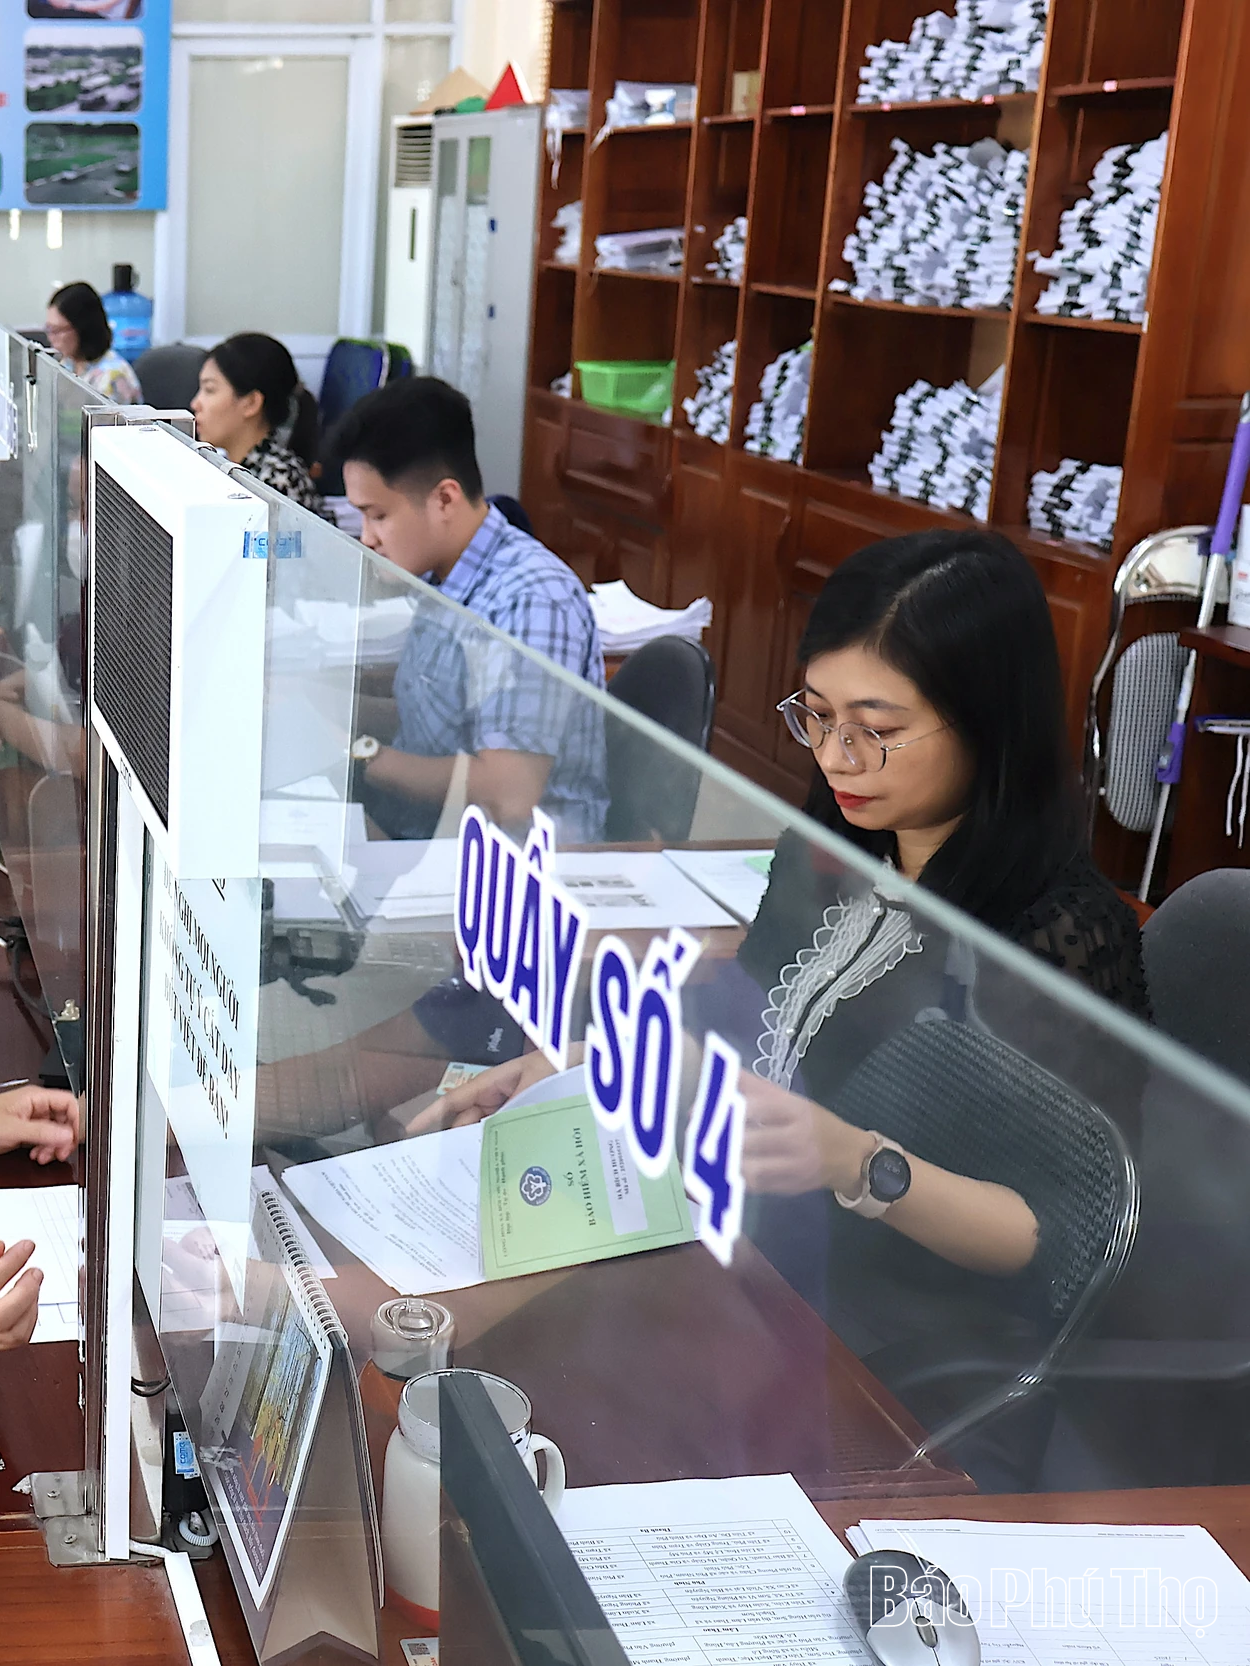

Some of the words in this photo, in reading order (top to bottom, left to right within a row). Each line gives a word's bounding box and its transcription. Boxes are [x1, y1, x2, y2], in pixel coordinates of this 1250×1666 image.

[159, 910, 184, 982] KHÔNG
[184, 957, 198, 1011] TỰ
[221, 1047, 241, 1101] DÂY
[192, 917, 209, 972] MỌI
[210, 956, 240, 1031] NGƯỜI
[456, 810, 585, 1063] QUẦY
[588, 934, 693, 1170] SỐ
[688, 1040, 741, 1251] 4
[177, 1001, 197, 1062] VIẾT
[208, 1074, 229, 1140] BÀN!
[572, 1127, 584, 1148] HỘI
[578, 1169, 591, 1200] HIỂM
